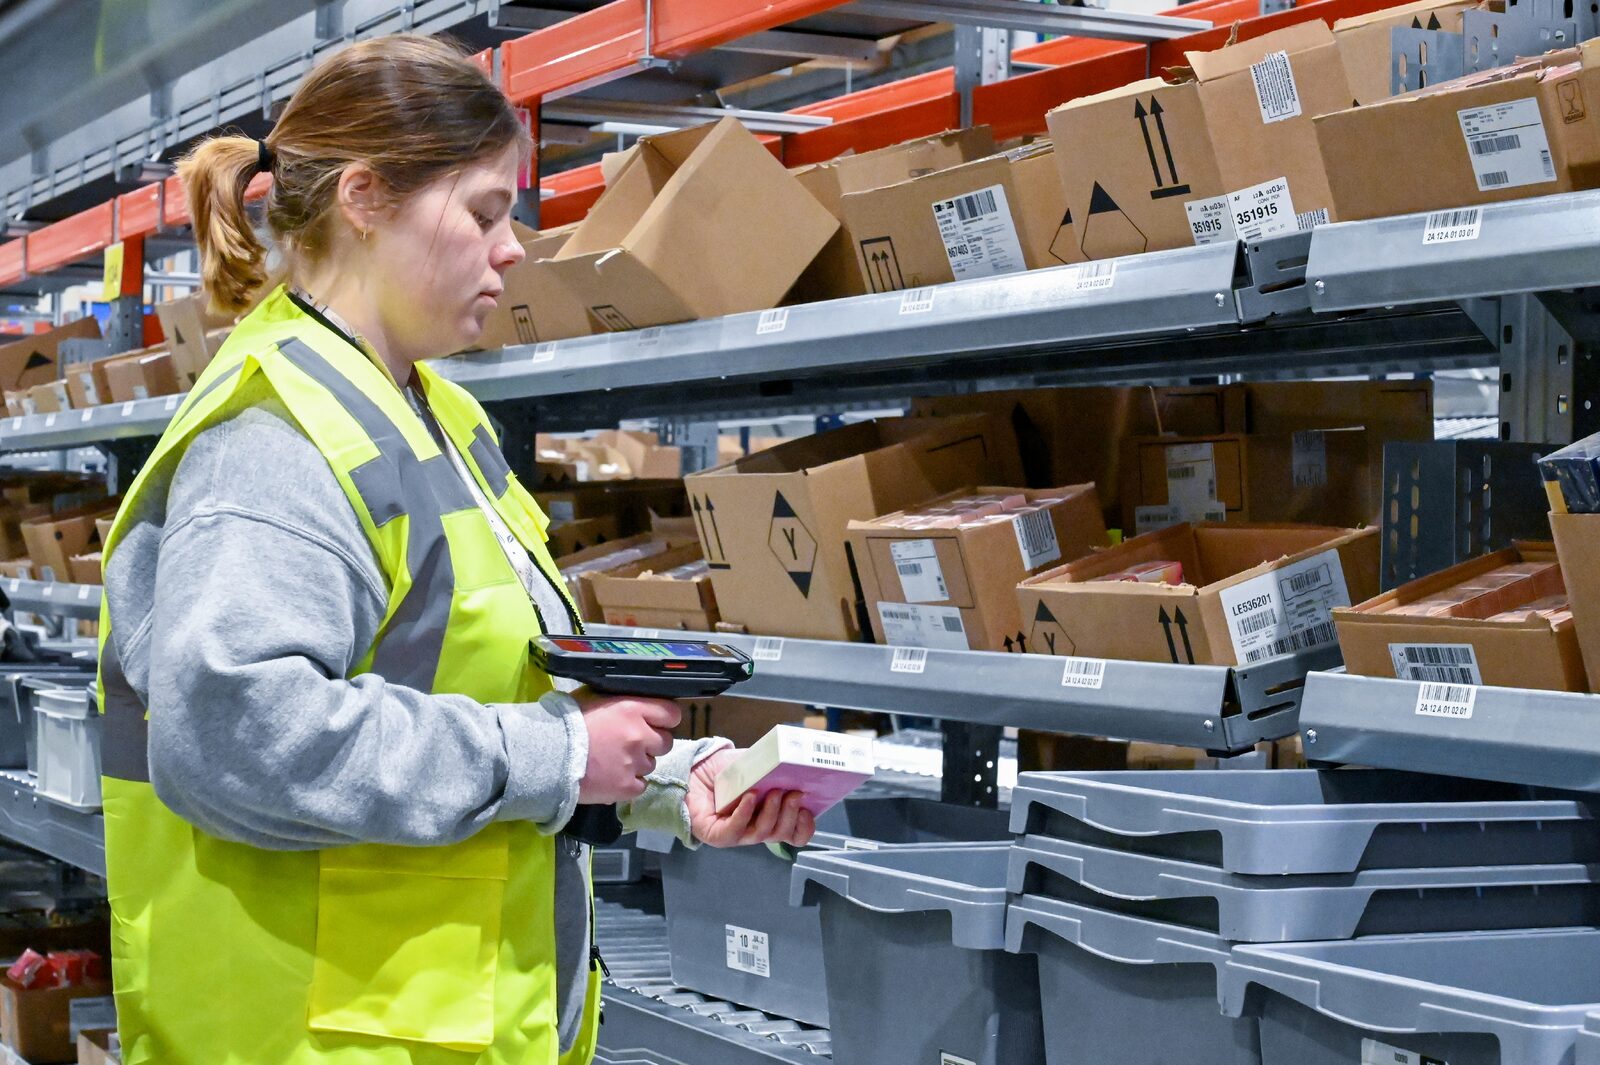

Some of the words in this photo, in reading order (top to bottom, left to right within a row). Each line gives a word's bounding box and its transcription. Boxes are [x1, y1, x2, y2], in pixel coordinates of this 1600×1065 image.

[1236, 202, 1278, 225] 351915
[1192, 218, 1222, 234] 351915
[1427, 233, 1434, 241] 2A
[1450, 230, 1458, 238] 01
[1458, 230, 1466, 238] 03
[948, 244, 968, 258] 867403
[782, 528, 798, 560] Y
[1232, 593, 1272, 616] LE536201
[1043, 632, 1055, 656] Y
[1420, 704, 1428, 712] 2A
[1430, 704, 1436, 712] 12
[1437, 705, 1442, 713] A
[1444, 706, 1450, 714] 01
[1452, 706, 1458, 714] 02
[740, 934, 748, 948] 10
